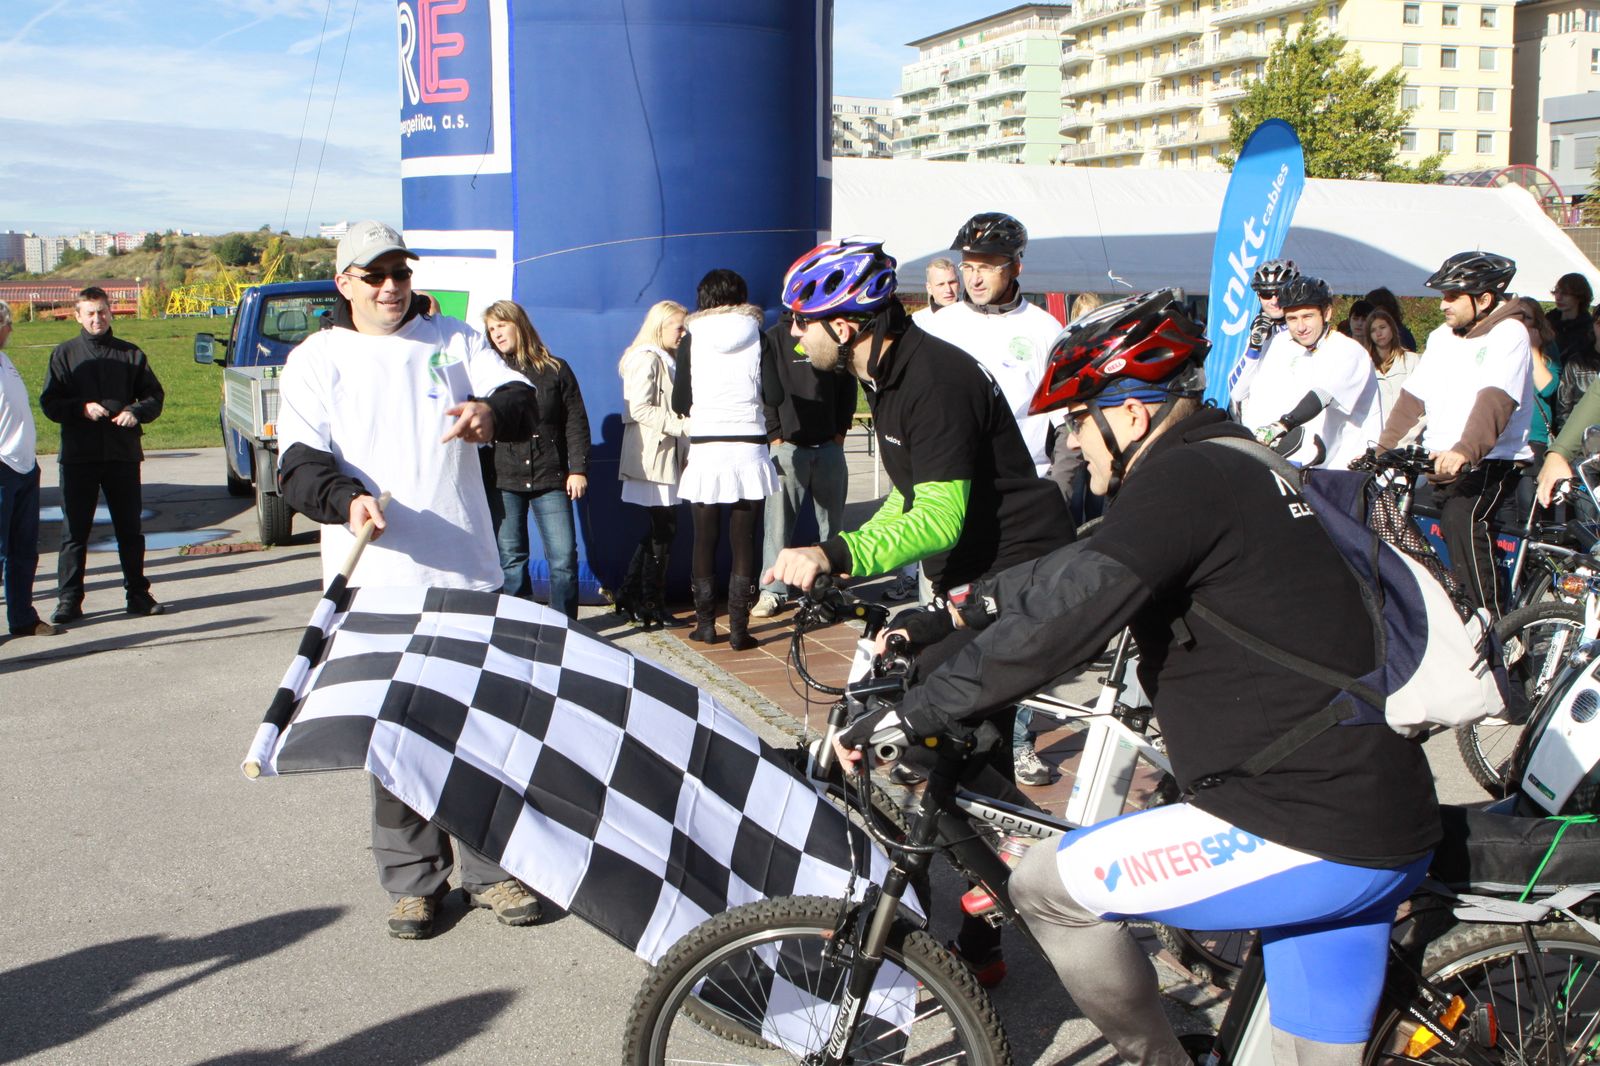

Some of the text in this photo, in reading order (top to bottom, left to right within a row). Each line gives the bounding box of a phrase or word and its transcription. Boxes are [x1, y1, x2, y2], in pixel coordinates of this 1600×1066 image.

[442, 114, 469, 129] a.s.
[1262, 163, 1289, 227] cables
[1222, 215, 1267, 318] nkt
[1409, 1006, 1456, 1047] WWW.AGOGS.COM
